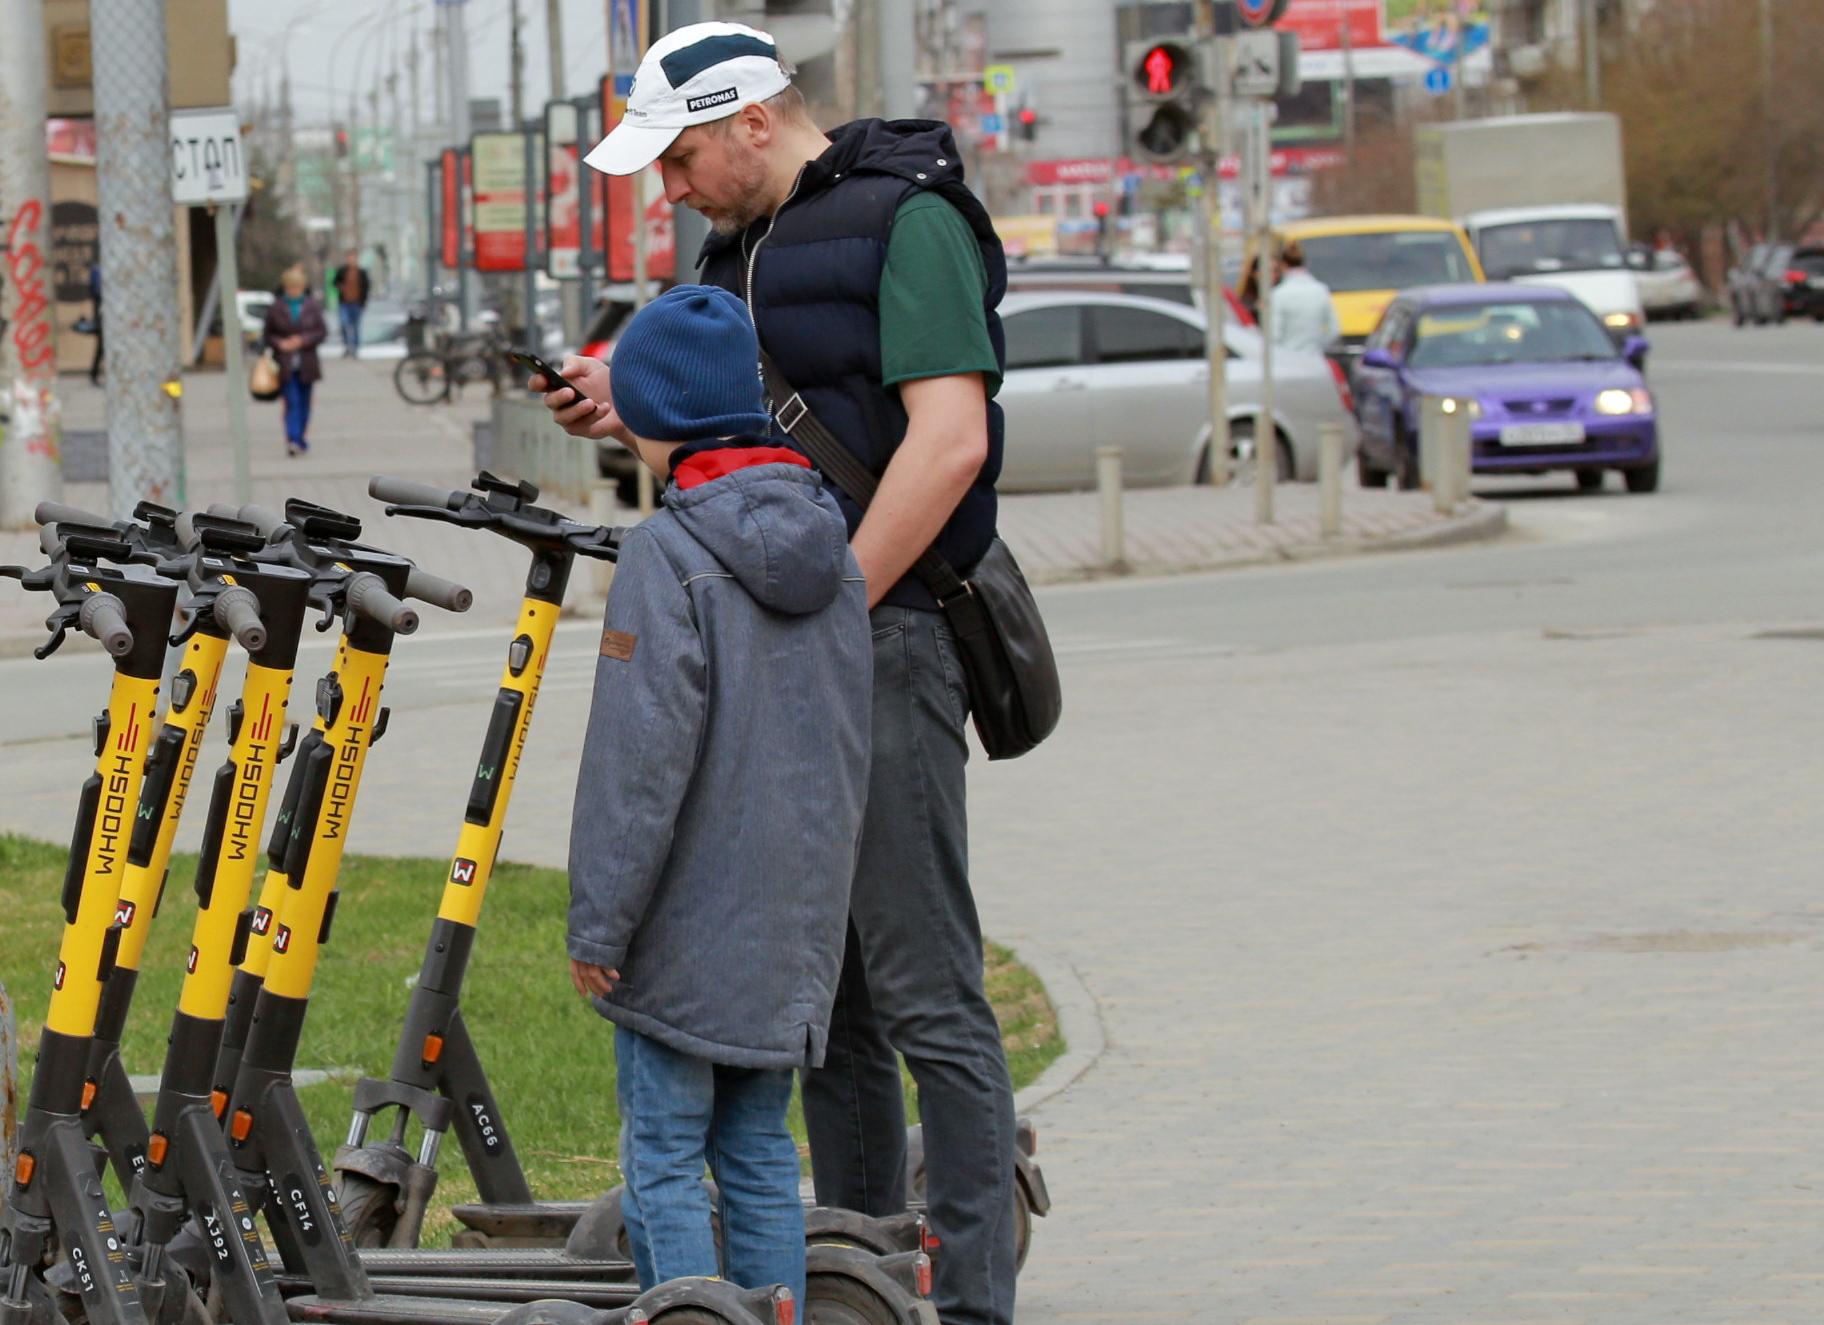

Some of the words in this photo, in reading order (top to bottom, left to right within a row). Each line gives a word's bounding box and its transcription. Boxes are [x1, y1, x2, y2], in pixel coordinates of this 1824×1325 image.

[689, 89, 736, 110] PETRONAS
[169, 710, 209, 820] WHOOSH
[508, 674, 543, 781] WHOOSH
[95, 755, 133, 875] WHOOSH
[227, 744, 266, 860] WHOOSH
[322, 726, 363, 840] WHOOSH
[471, 1104, 498, 1146] AC66
[204, 1214, 229, 1260] AJ92
[291, 1188, 313, 1231] CF14
[72, 1247, 94, 1292] CK51
